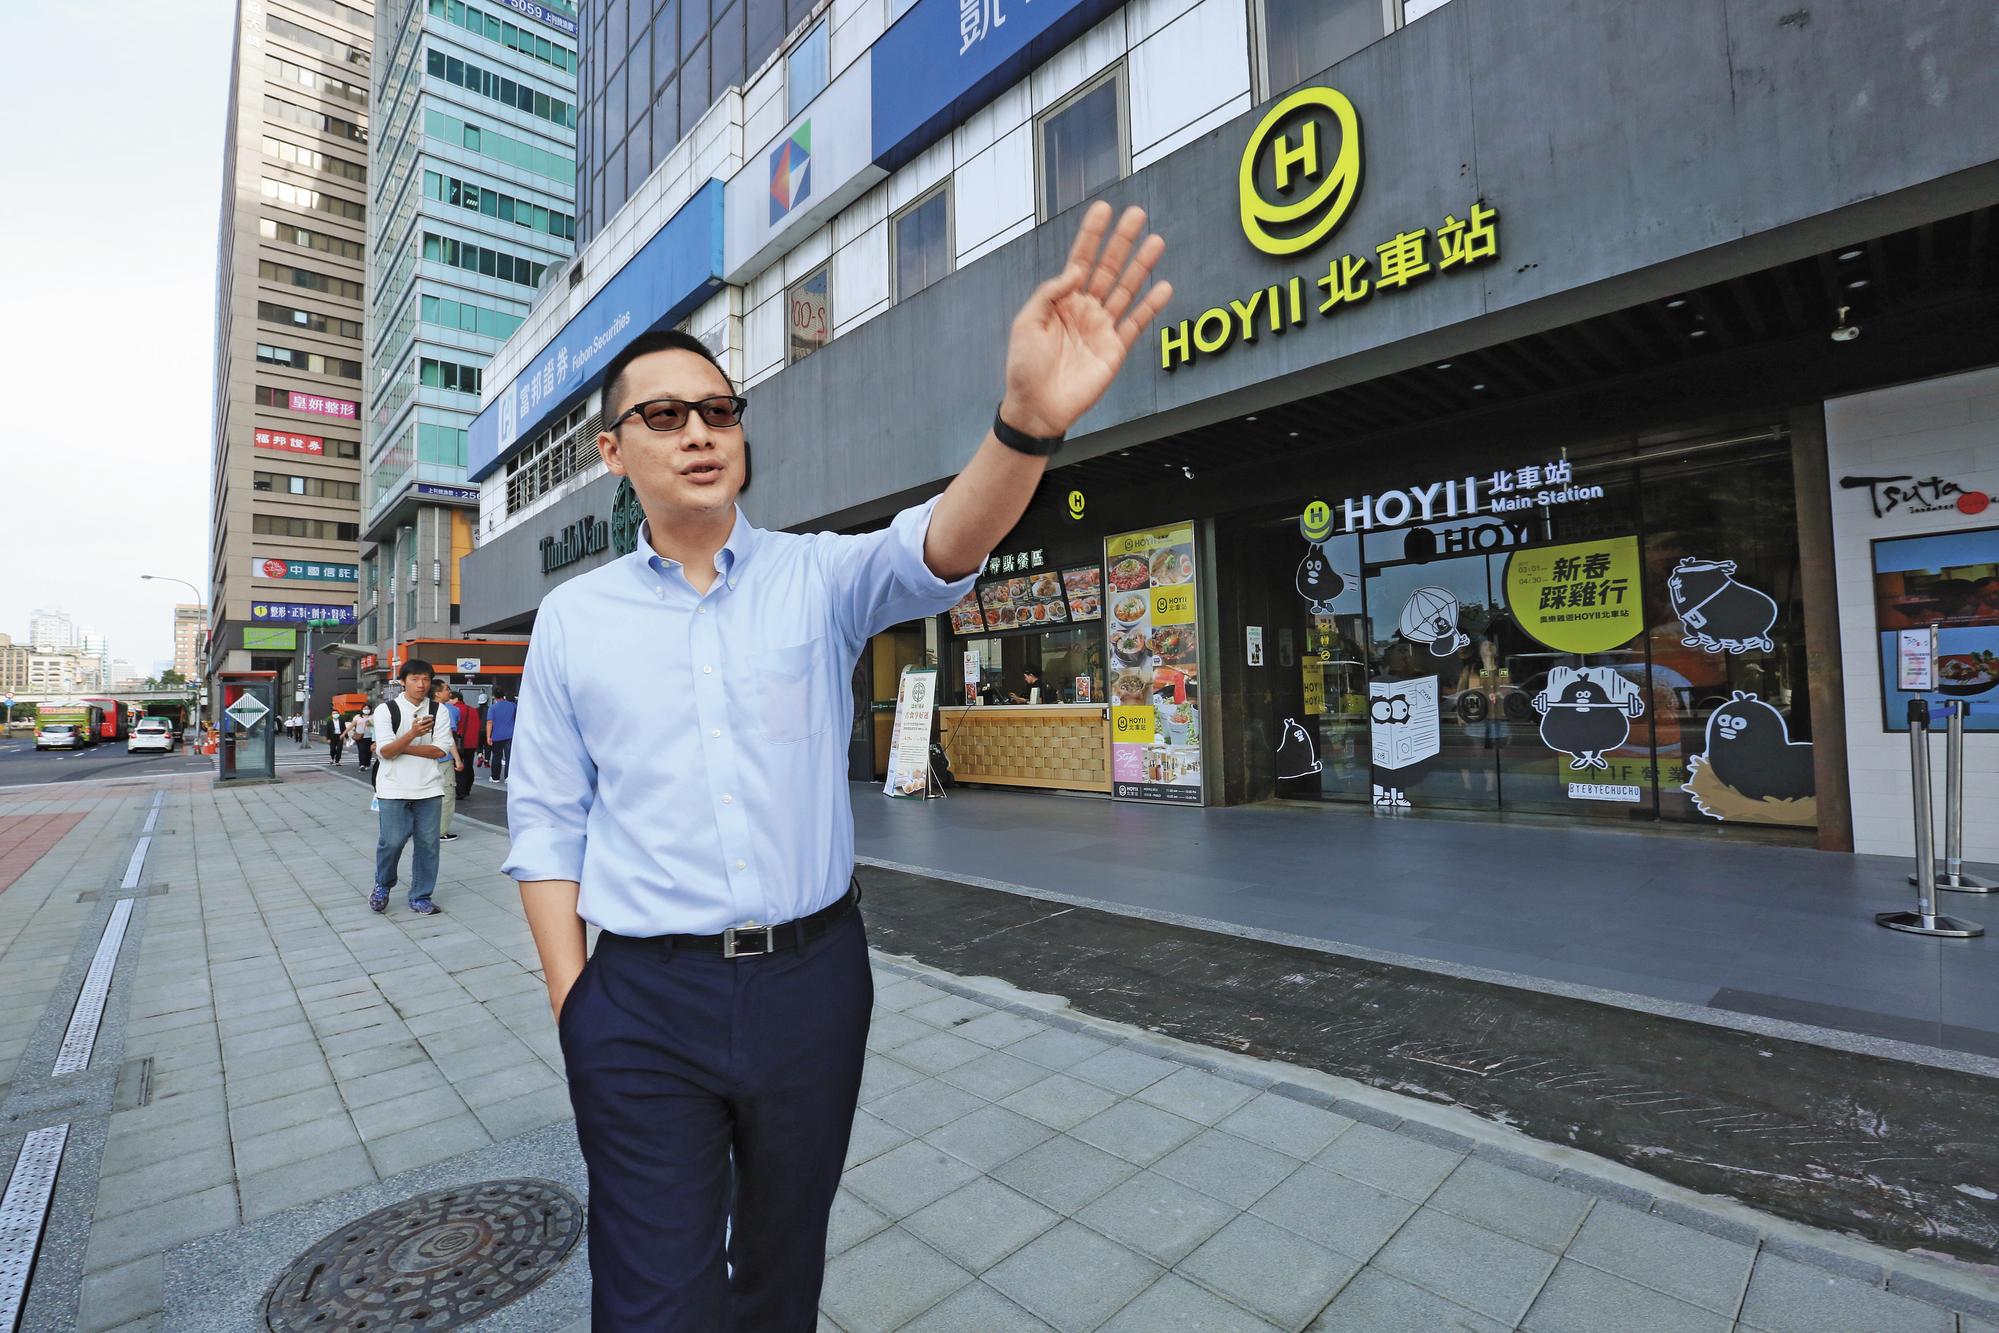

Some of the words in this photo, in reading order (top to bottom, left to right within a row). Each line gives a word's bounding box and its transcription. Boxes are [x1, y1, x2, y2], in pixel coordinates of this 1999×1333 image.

[1160, 275, 1304, 369] HOYII
[1317, 203, 1498, 315] 北車站
[520, 346, 569, 419] 富邦證券
[572, 344, 593, 373] Fubon
[593, 311, 631, 354] Securities
[291, 395, 355, 416] 皇妍整形
[1488, 459, 1572, 495] 北車站
[1344, 476, 1478, 533] HOYII
[1491, 494, 1533, 513] Main
[1537, 484, 1604, 506] Station
[1840, 476, 1972, 518] Tsuta
[1539, 578, 1629, 610] 踩雞行
